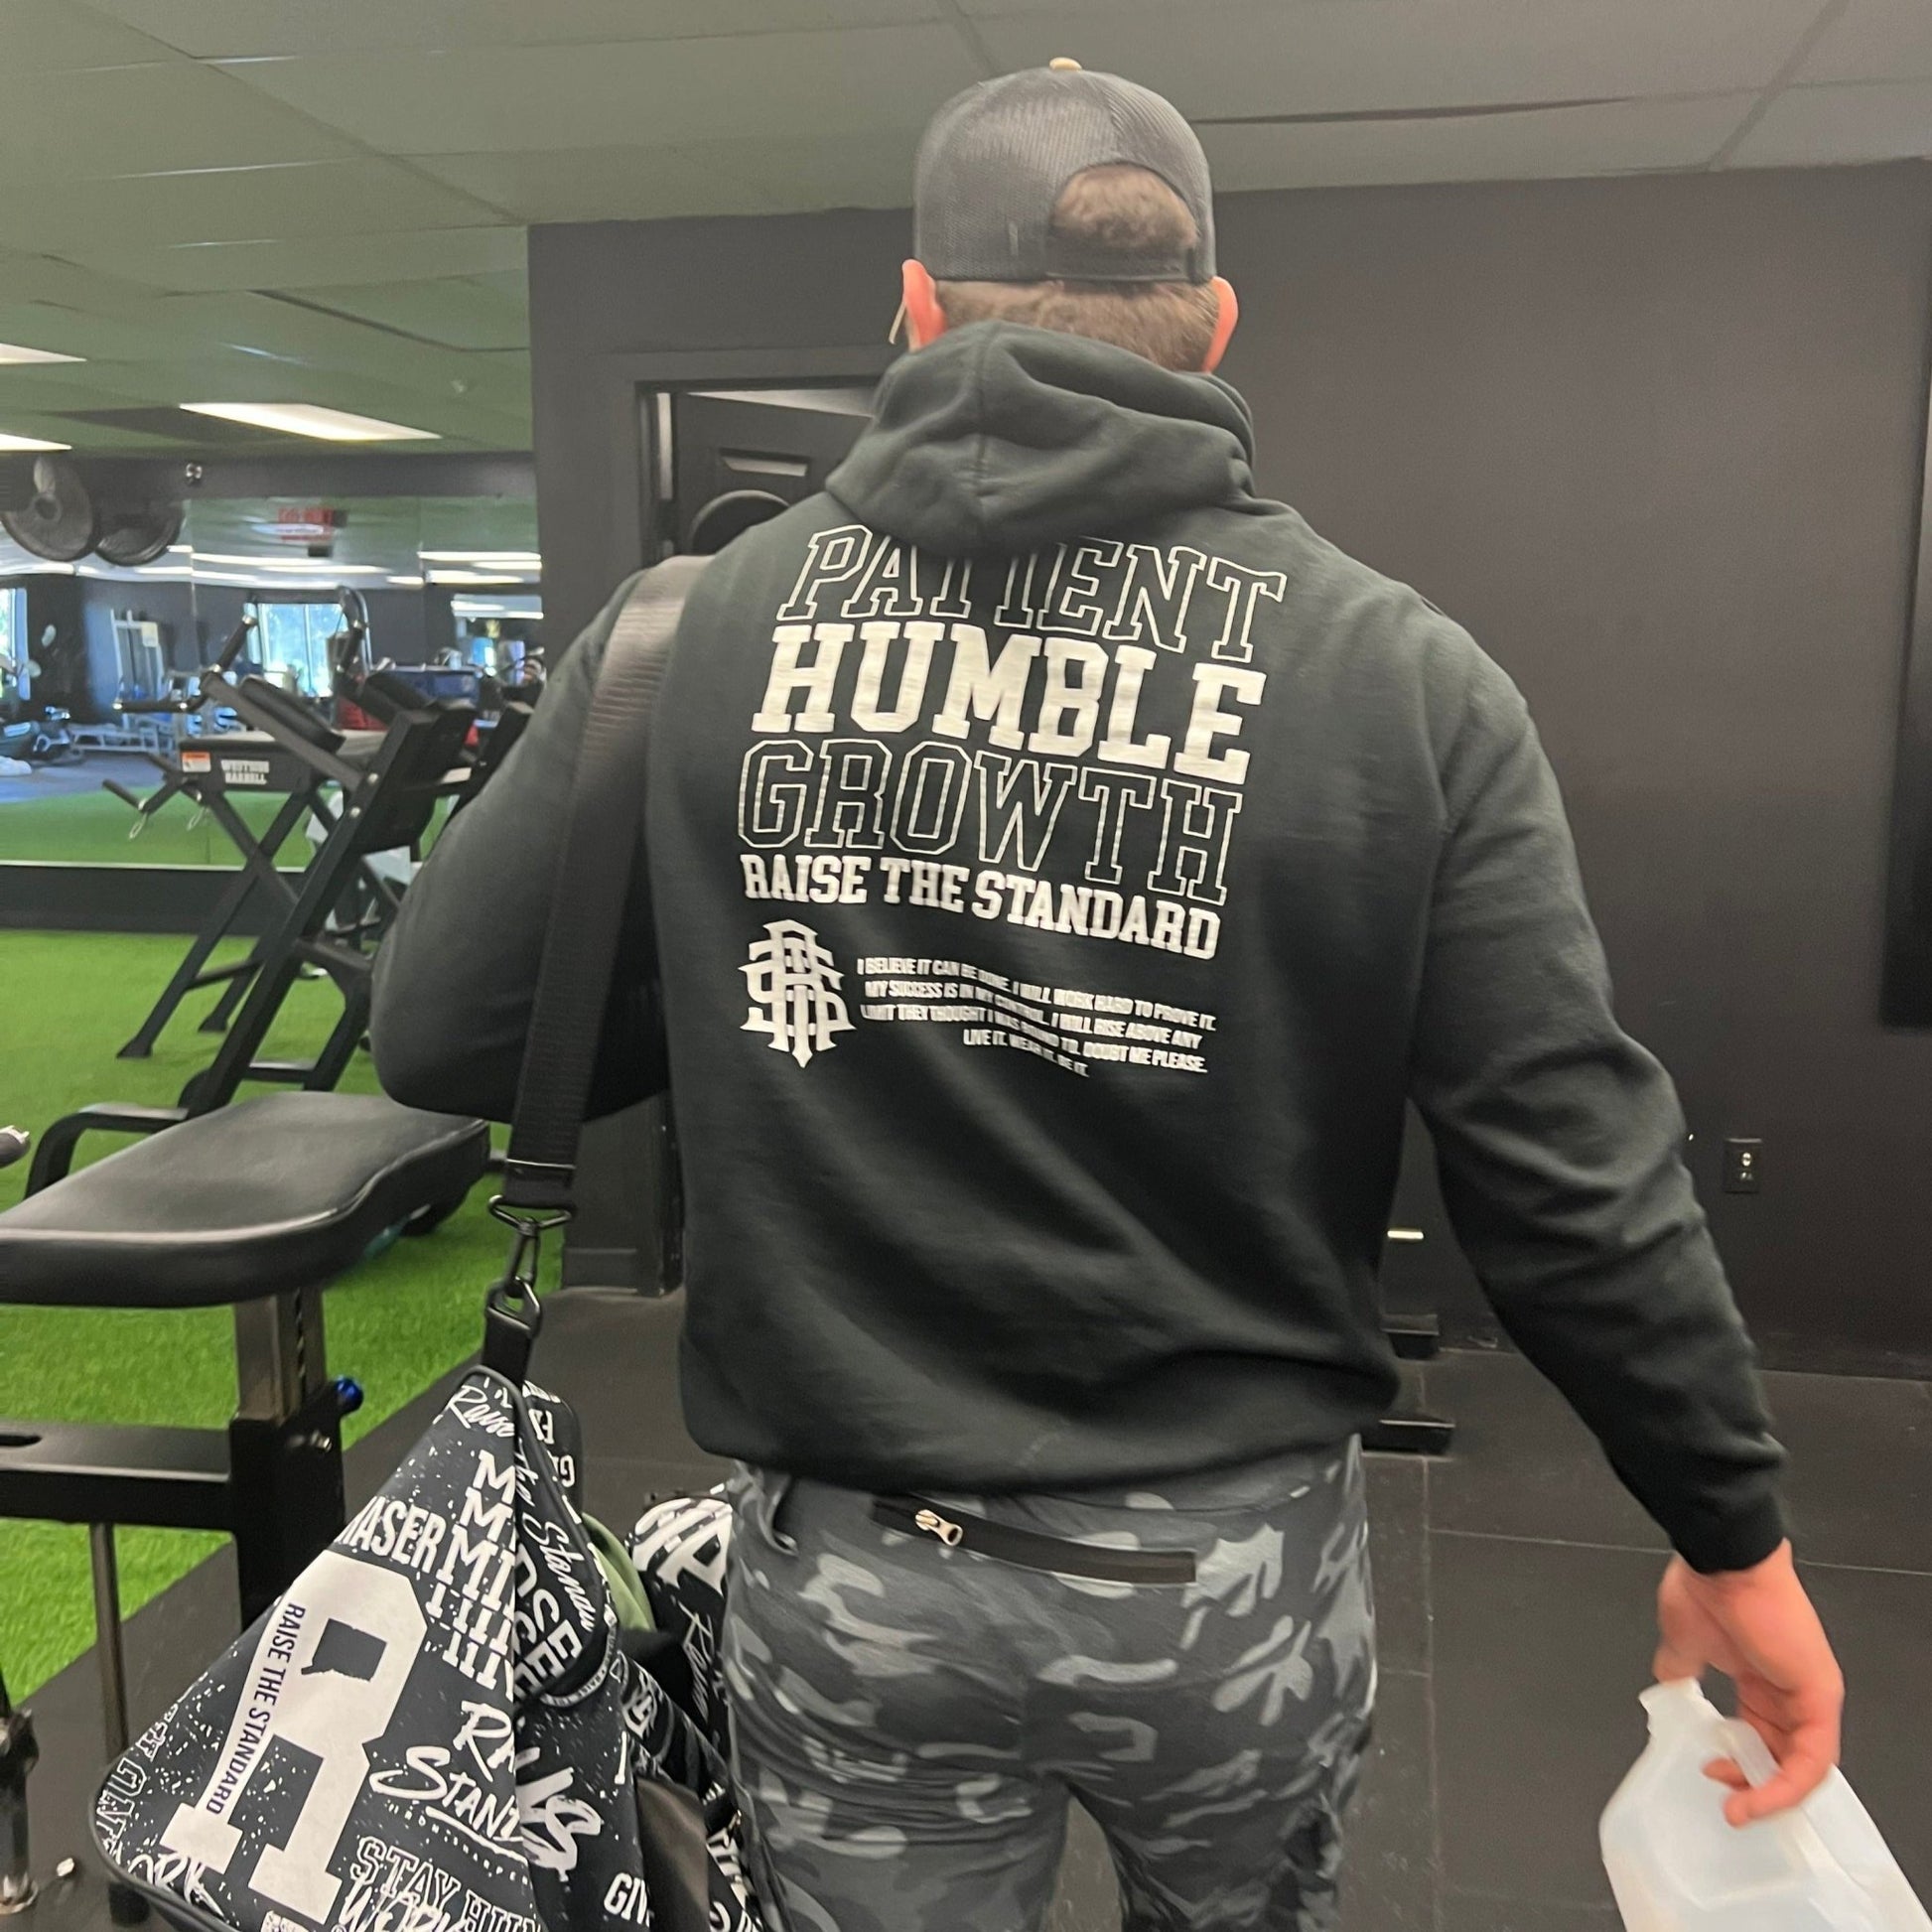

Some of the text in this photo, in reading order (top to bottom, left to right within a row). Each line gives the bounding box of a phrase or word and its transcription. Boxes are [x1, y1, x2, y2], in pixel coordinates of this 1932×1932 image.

[751, 621, 1267, 785] HUMBLE
[738, 739, 1243, 905] GROWTH
[740, 854, 1221, 960] RAISE THE STANDARD
[889, 980, 943, 999] SUCCESS
[943, 982, 958, 999] IS
[206, 1602, 306, 1815] RAISE THE STANDARD
[349, 1836, 462, 1912] STAY
